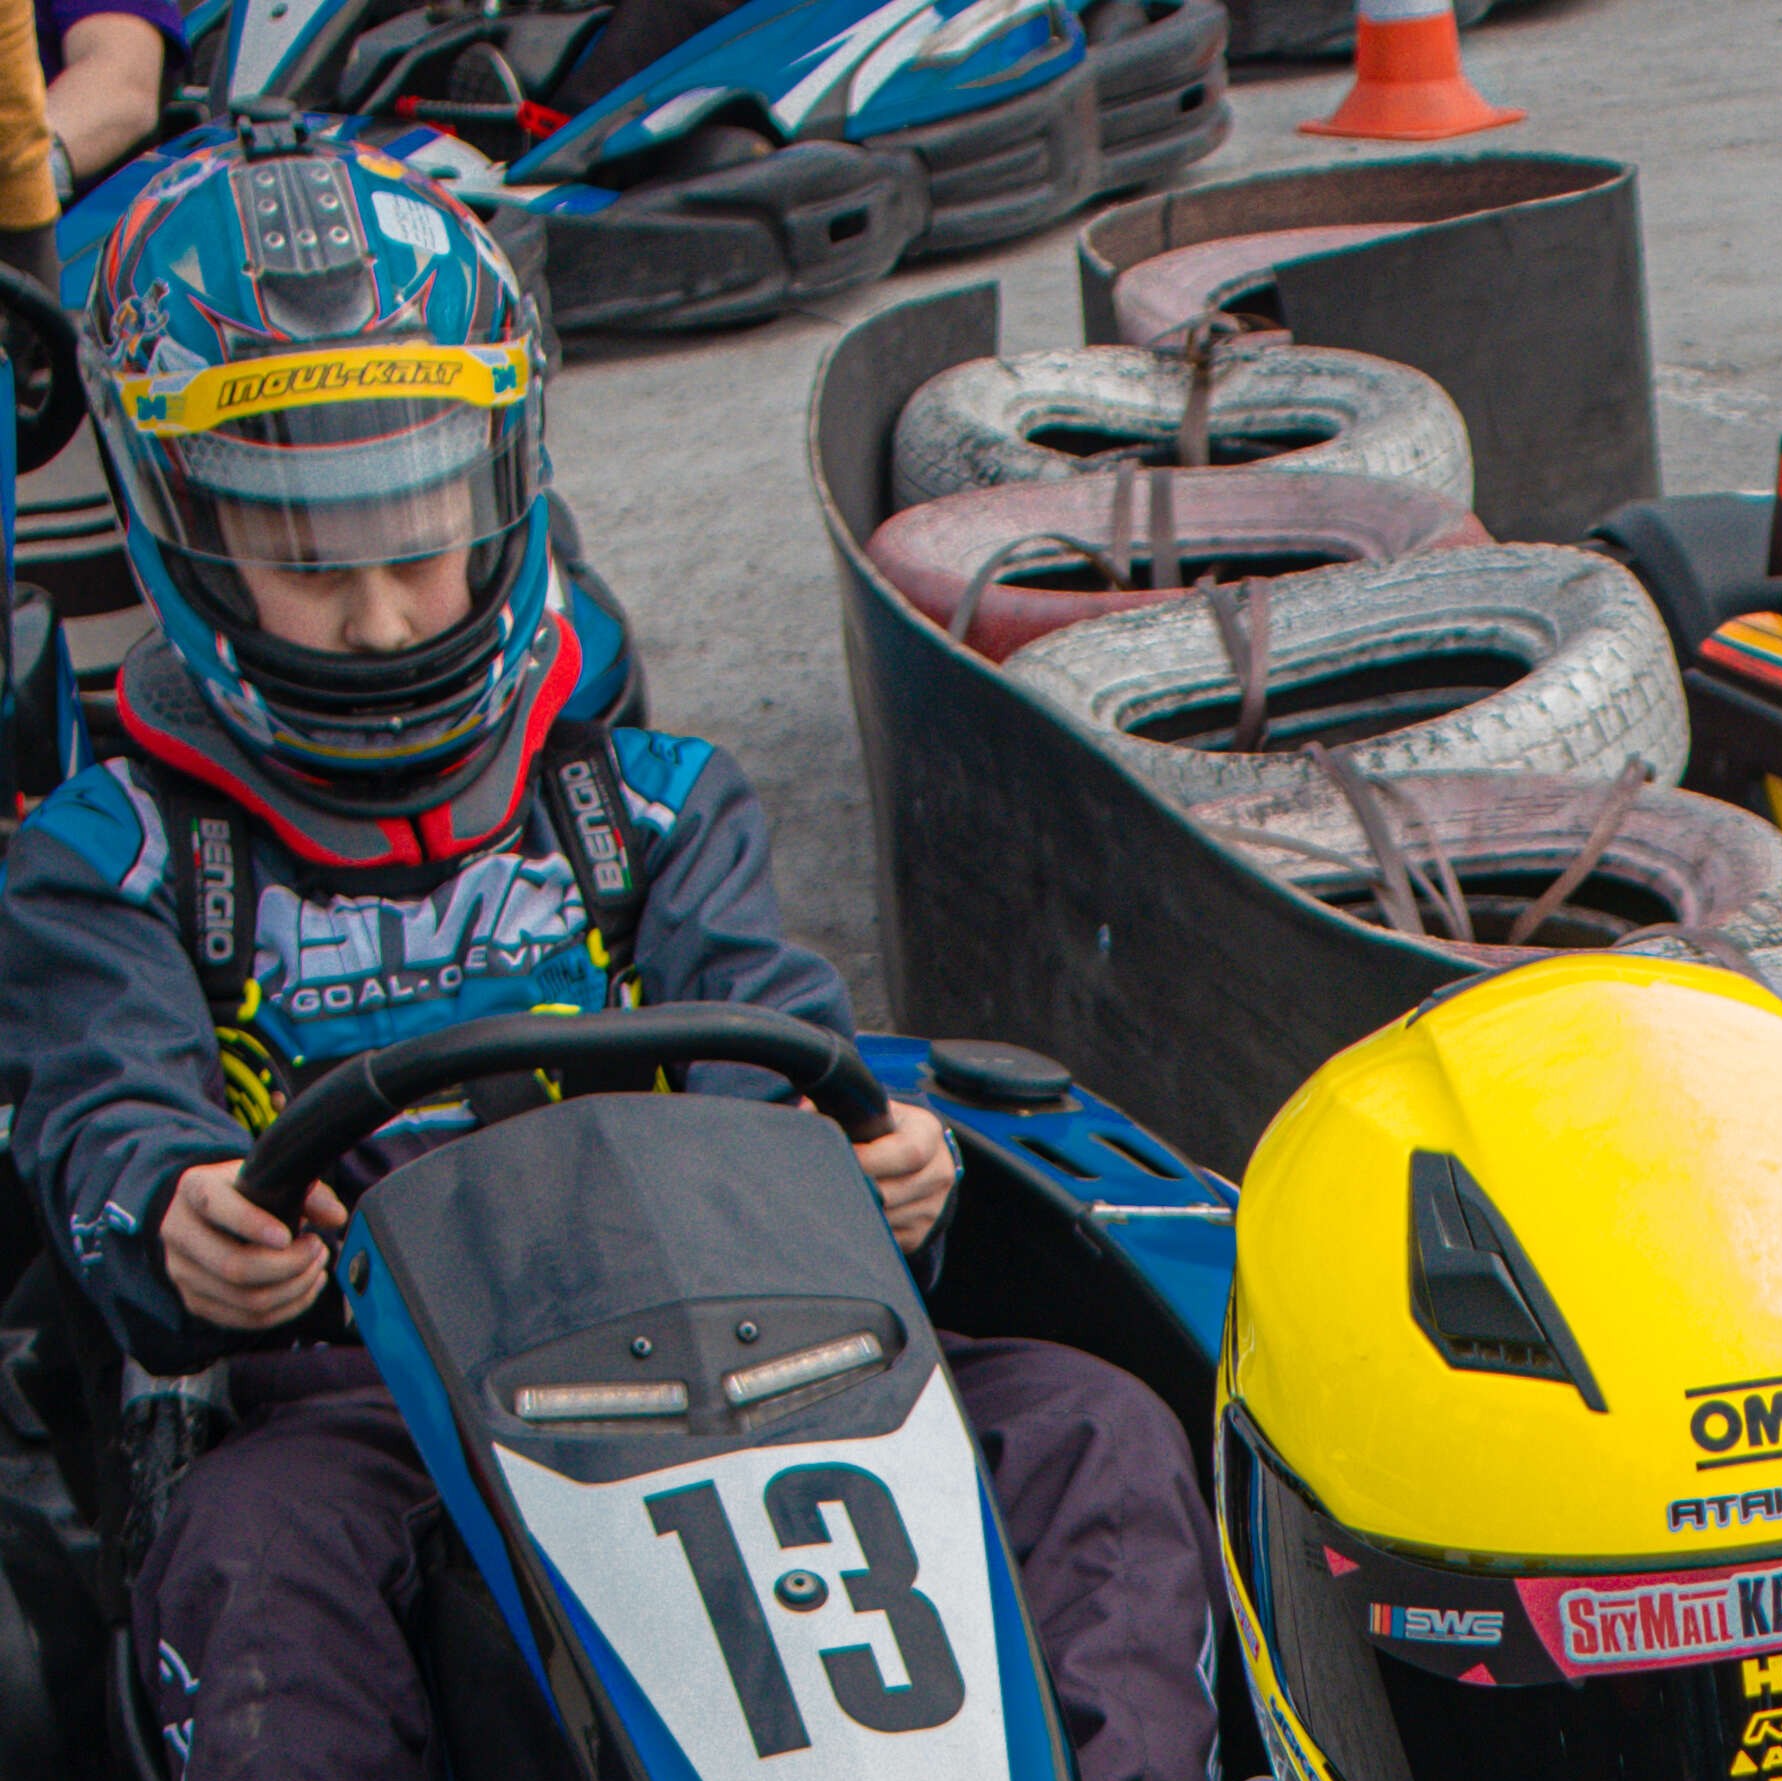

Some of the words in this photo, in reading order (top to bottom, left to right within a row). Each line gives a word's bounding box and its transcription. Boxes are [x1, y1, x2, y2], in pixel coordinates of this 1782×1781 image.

[201, 818, 235, 964] BENGIO
[560, 760, 625, 895] BENGIO
[643, 1461, 966, 1760] 13
[1405, 1607, 1503, 1645] SWS
